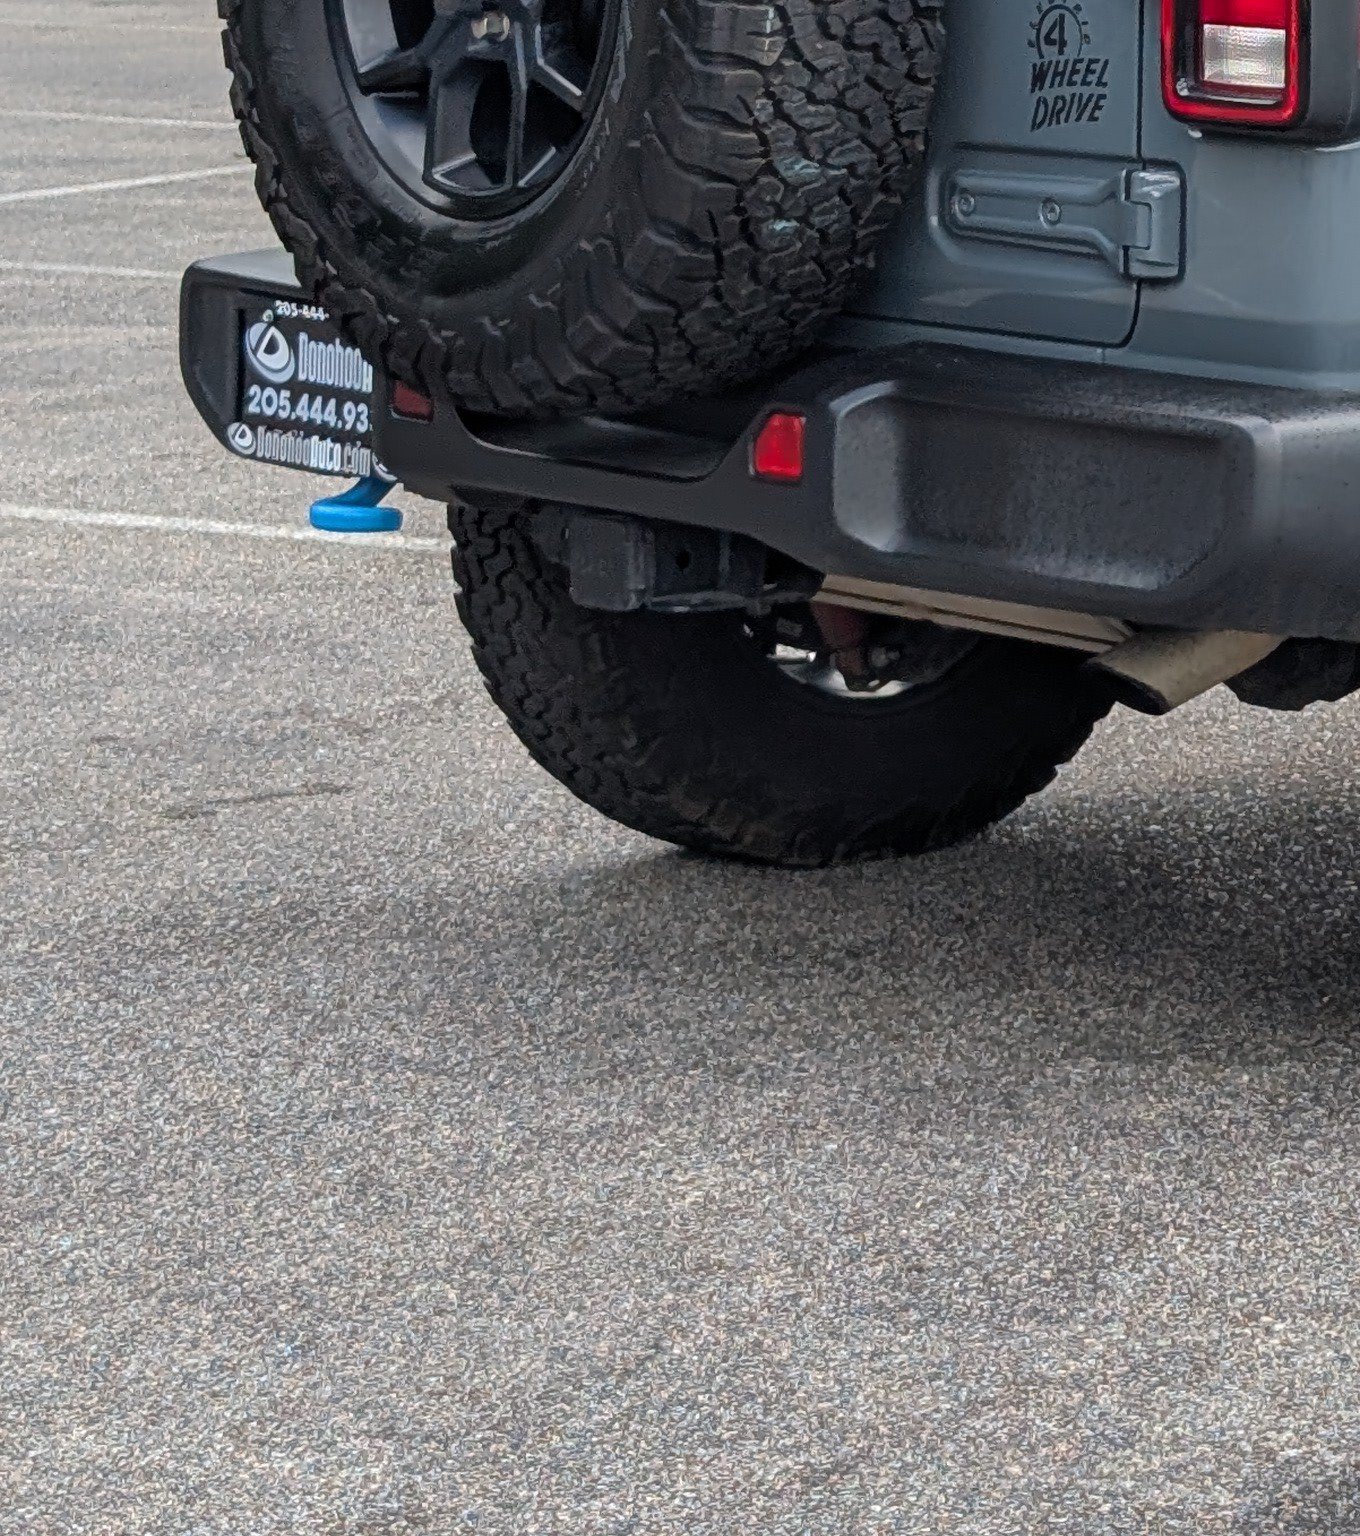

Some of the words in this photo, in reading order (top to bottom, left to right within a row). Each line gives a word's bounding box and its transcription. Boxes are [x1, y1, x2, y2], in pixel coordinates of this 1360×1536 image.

[1044, 14, 1067, 56] 4
[1031, 58, 1110, 94] WHEEL
[1031, 93, 1107, 132] DRIVE
[248, 383, 373, 434] 205.444.93
